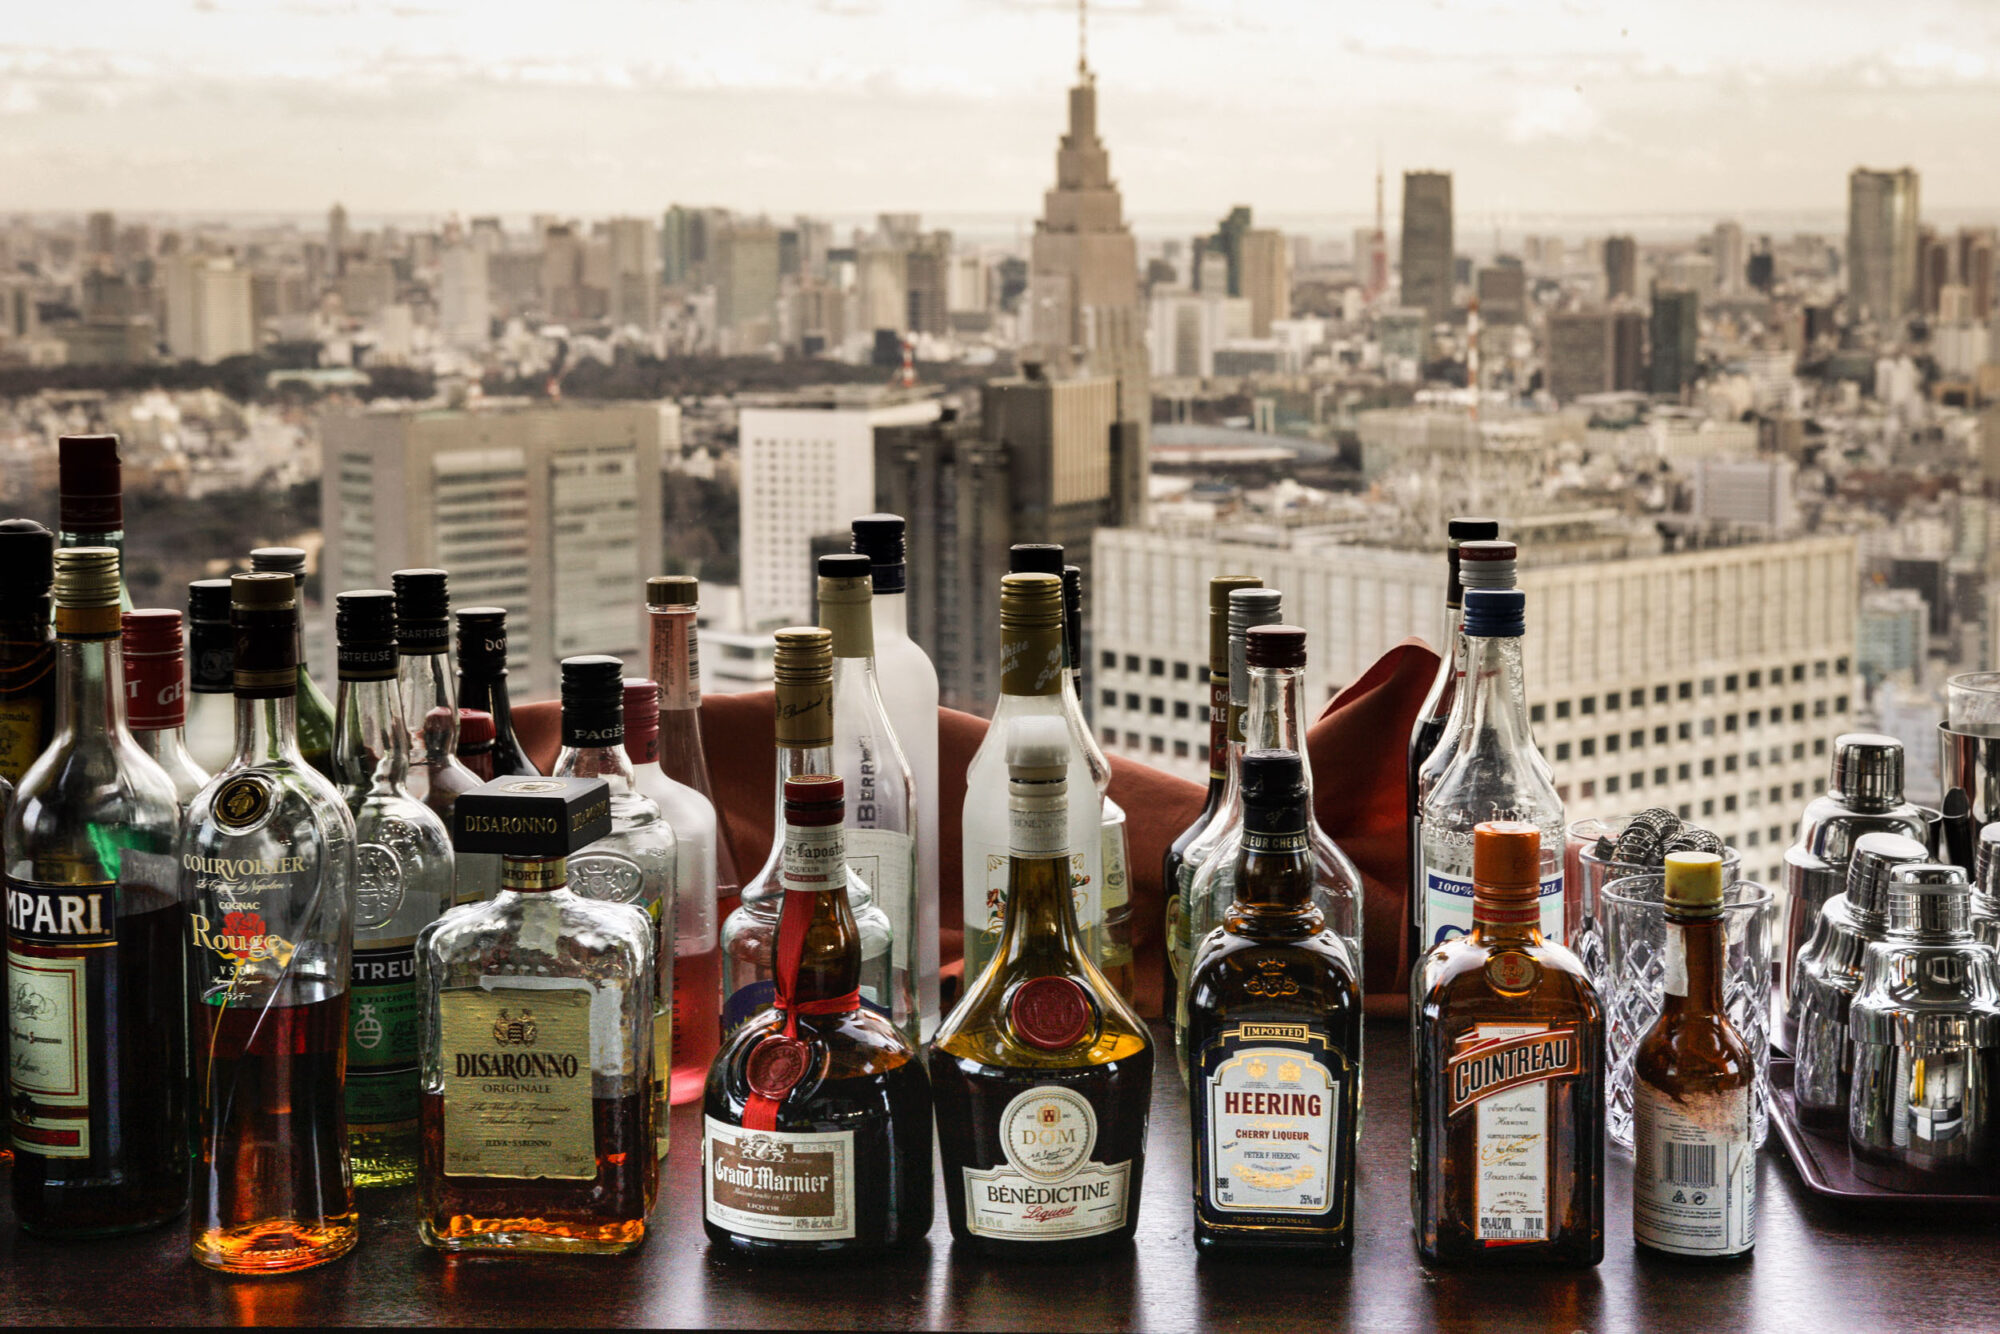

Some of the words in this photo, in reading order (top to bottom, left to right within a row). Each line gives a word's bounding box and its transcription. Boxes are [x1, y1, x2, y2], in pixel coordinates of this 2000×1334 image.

[465, 815, 558, 834] DISARONNO
[183, 854, 306, 882] COURVOISIER
[1437, 881, 1473, 895] 100%
[218, 902, 261, 910] COGNAC
[191, 913, 281, 957] Rouge
[1246, 1026, 1303, 1036] IMPORTED
[456, 1053, 578, 1079] DISARONNO
[1454, 1039, 1569, 1104] COINTREAU
[482, 1084, 551, 1094] ORIGINALE
[1225, 1092, 1321, 1117] HEERING
[1235, 1129, 1270, 1139] CHERRY
[1272, 1131, 1310, 1141] LIQUEUR
[1271, 1152, 1301, 1160] HEERING
[715, 1157, 753, 1187] Grand
[753, 1166, 829, 1192] Marnier
[987, 1181, 1110, 1204] BÉNÉDICTINE
